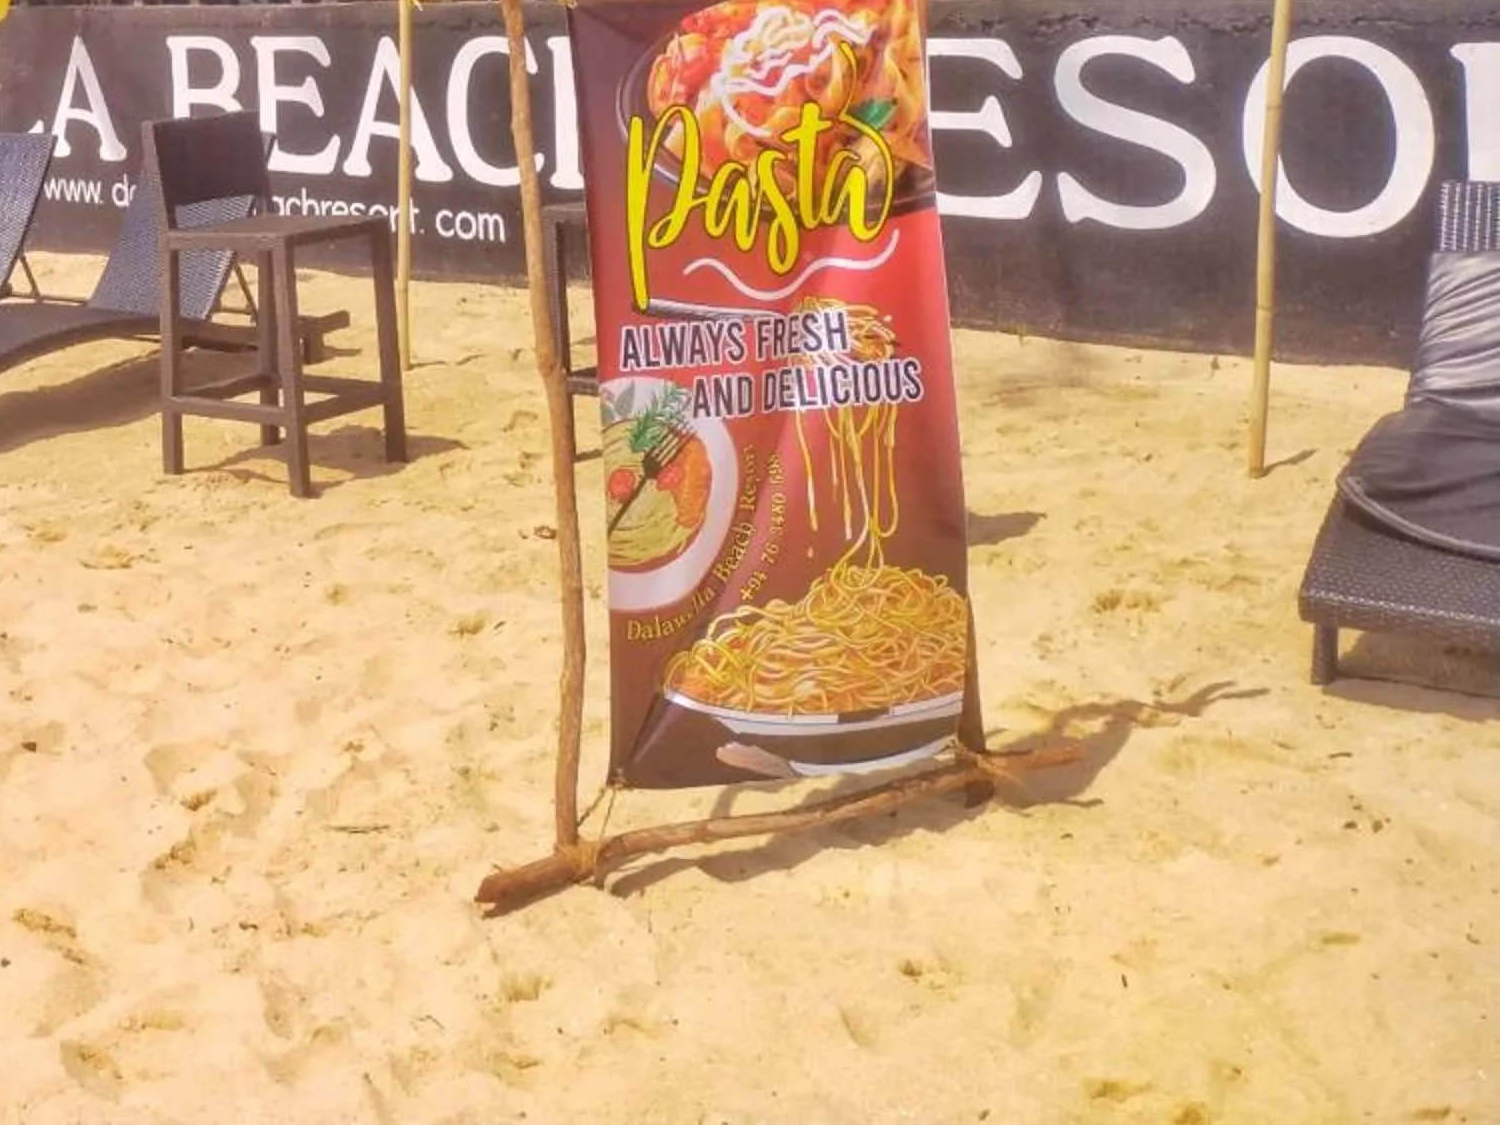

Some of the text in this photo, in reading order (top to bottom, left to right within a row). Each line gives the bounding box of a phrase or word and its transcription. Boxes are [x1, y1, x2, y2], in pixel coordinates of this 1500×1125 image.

[625, 42, 895, 313] Pasta
[619, 309, 851, 370] ALWAYS FRESH
[692, 359, 923, 420] AND DELICIOUS
